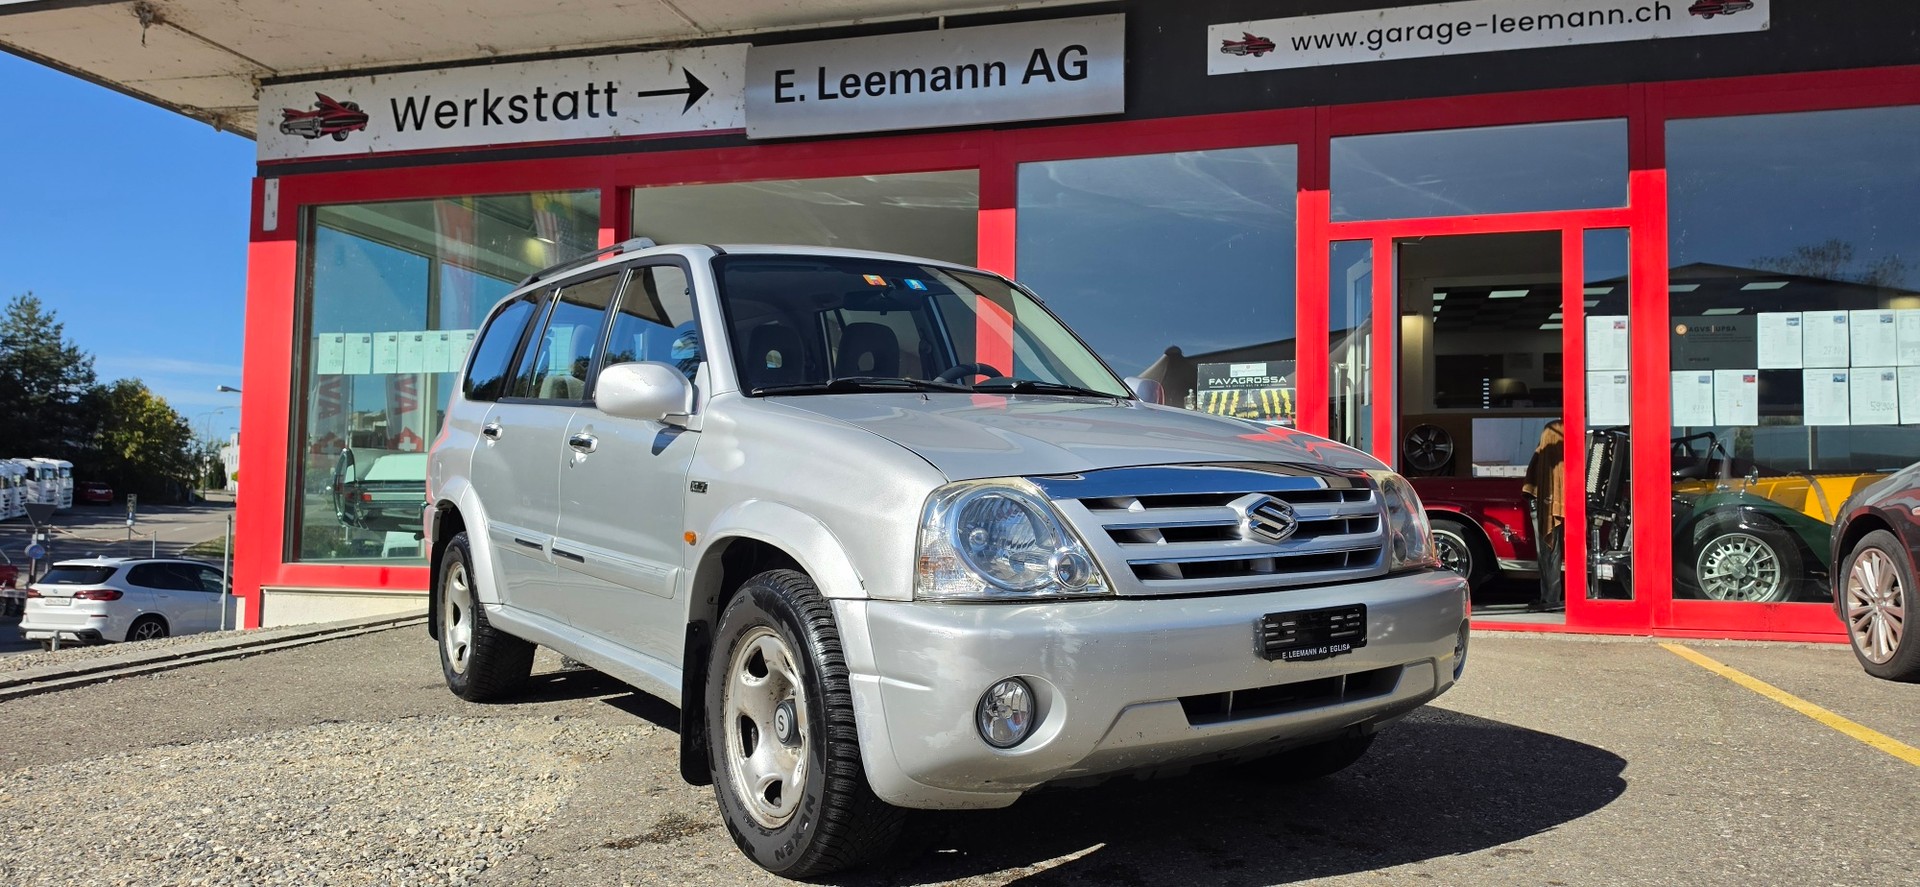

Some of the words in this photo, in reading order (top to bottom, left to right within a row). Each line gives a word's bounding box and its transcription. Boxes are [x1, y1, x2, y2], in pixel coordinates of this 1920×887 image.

[1291, 1, 1671, 51] www.garage-leemann.ch
[774, 69, 805, 103] E.
[817, 63, 1006, 101] Leemann
[1021, 44, 1088, 85] AG
[390, 80, 618, 132] Werkstatt
[1208, 376, 1287, 385] FAVAGROSSA
[1288, 648, 1317, 658] LEEMANN
[1318, 646, 1327, 654] AG
[774, 793, 816, 862] NEXEN
